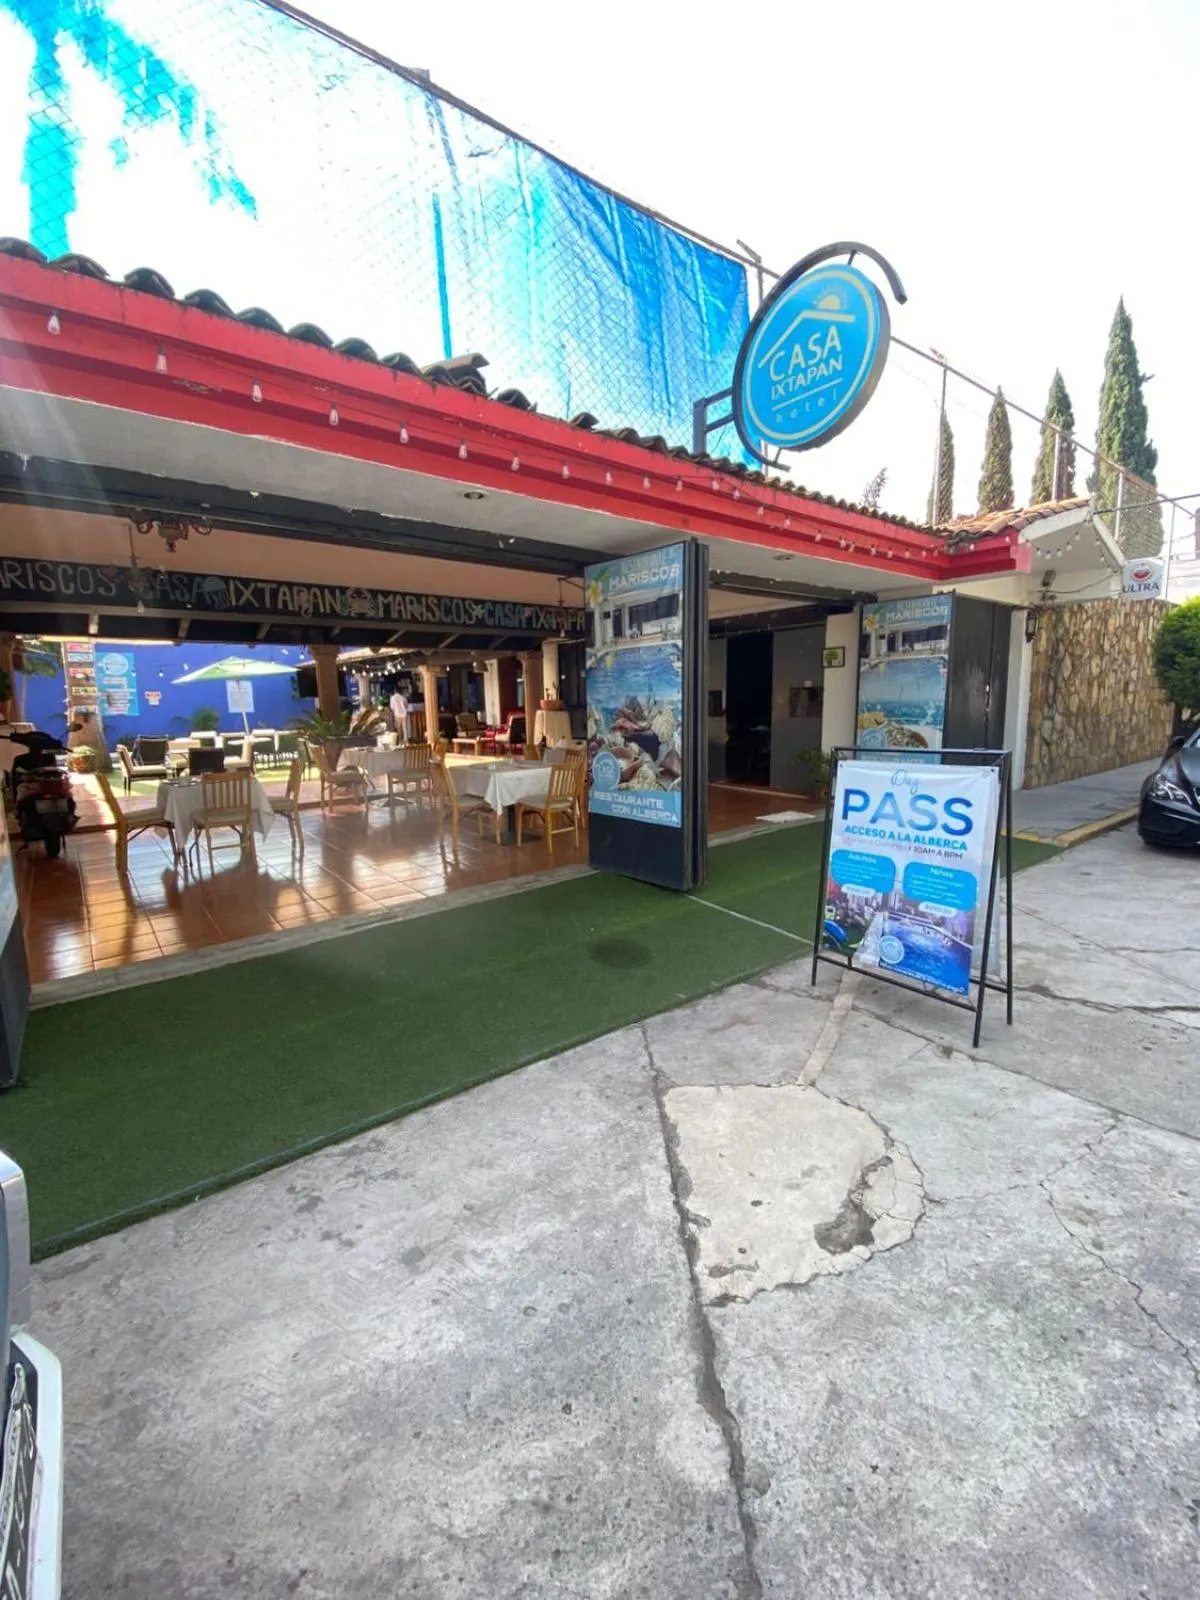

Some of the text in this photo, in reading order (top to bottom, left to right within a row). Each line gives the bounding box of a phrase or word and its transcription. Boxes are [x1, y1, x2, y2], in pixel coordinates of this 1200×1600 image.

[769, 325, 843, 382] CASA
[771, 353, 843, 400] IXTAPAN
[776, 388, 837, 423] hotel
[609, 563, 681, 591] MARISCOS
[1122, 582, 1159, 593] ULTRA
[376, 591, 477, 625] MARISCOS
[890, 768, 920, 795] Day
[841, 788, 974, 836] PASS
[844, 825, 968, 851] ACCESO A LA ALBERCA
